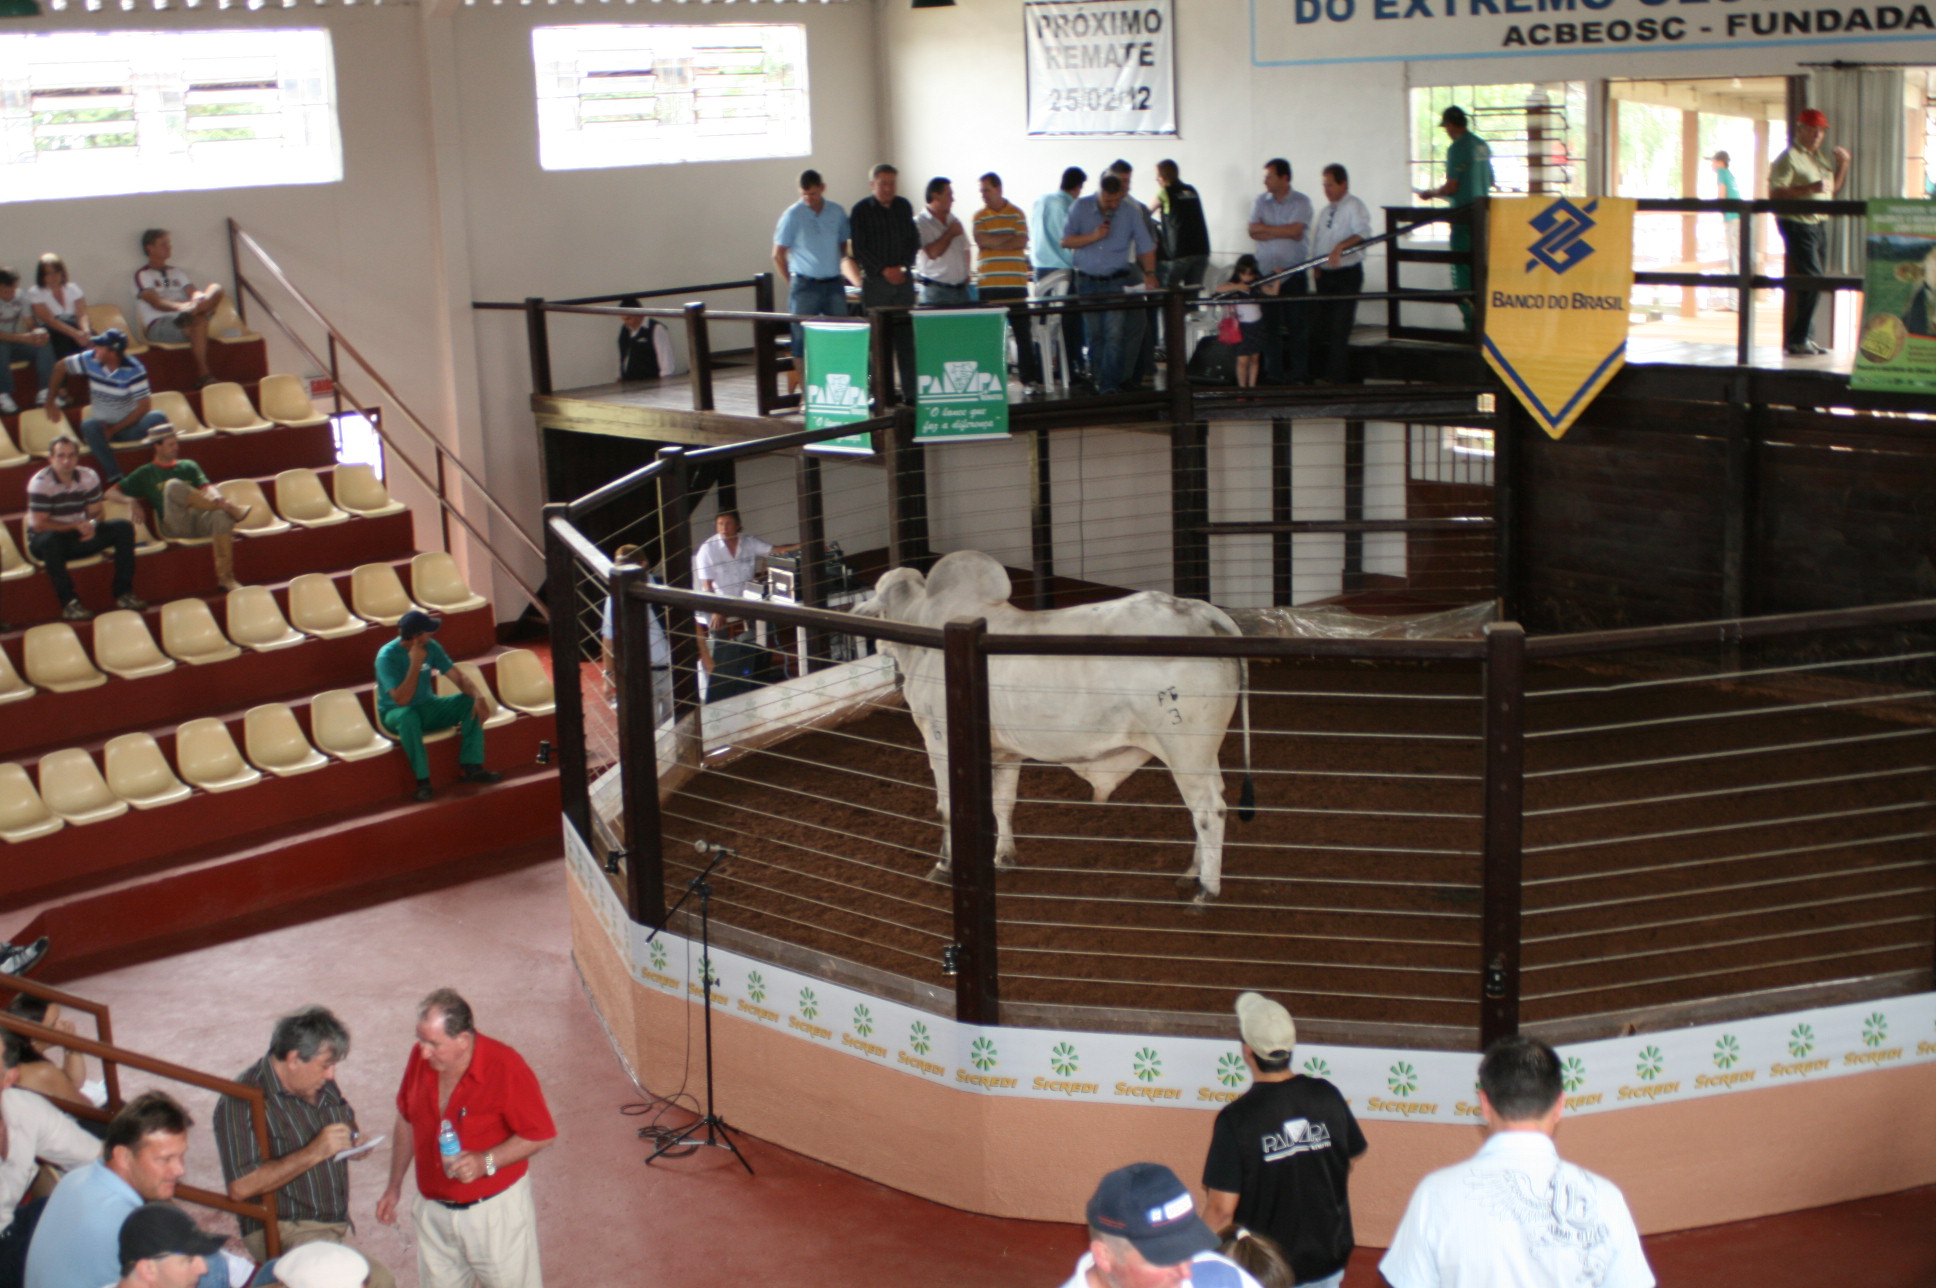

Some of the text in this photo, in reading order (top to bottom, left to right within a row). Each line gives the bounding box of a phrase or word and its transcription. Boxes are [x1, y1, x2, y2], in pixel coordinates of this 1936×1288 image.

[1037, 7, 1163, 39] PRÓXIMO
[1294, 0, 1356, 24] DO
[1502, 16, 1686, 47] ACBEOSC
[1726, 4, 1936, 36] FUNDADA
[1046, 42, 1155, 69] REMATE
[1492, 291, 1626, 311] BANCO DO BRASIL
[1197, 1087, 1243, 1103] SICR
